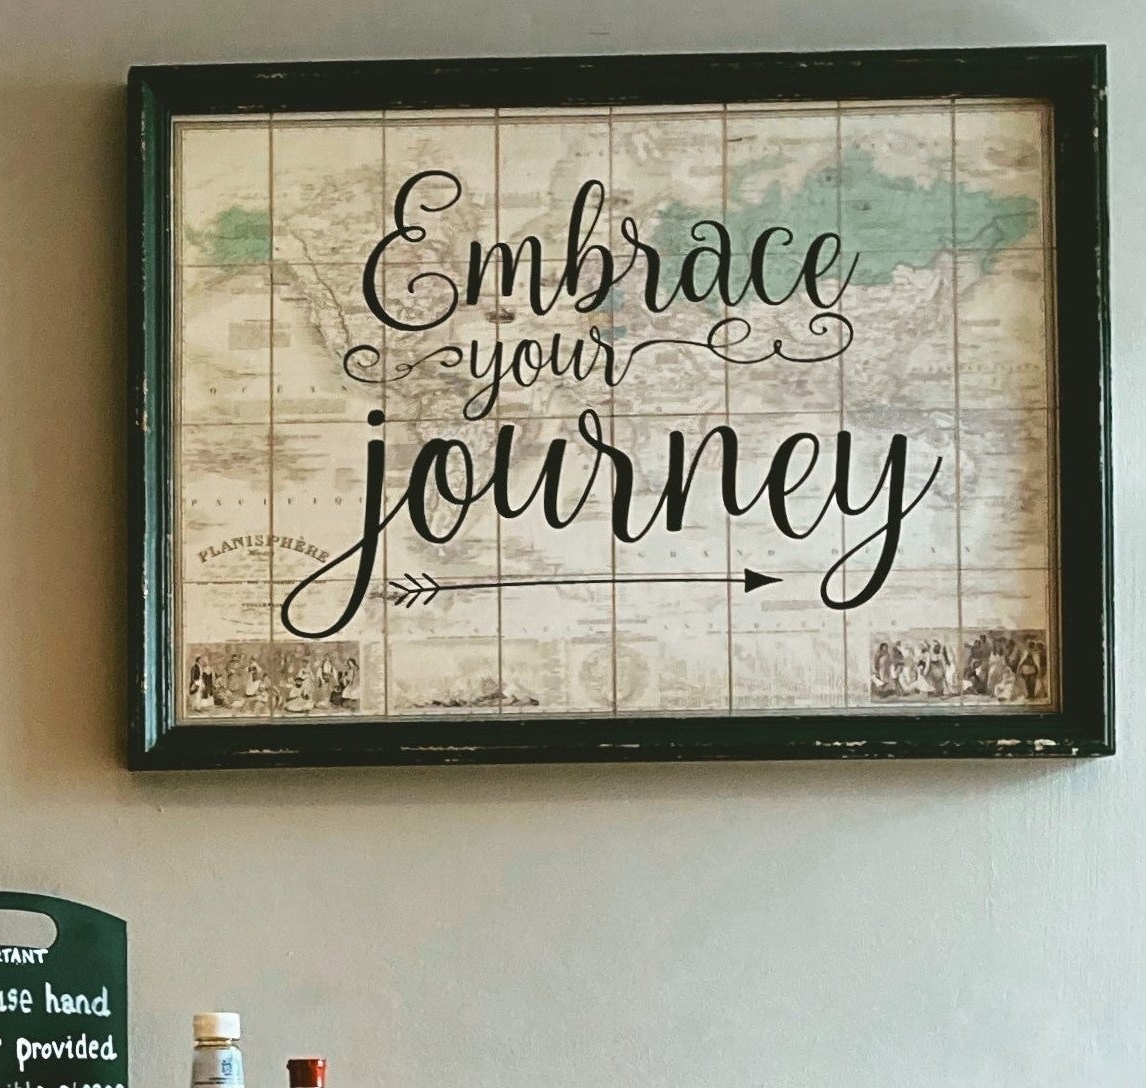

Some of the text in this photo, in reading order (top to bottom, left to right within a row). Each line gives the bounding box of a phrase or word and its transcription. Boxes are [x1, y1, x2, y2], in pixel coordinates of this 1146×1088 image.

[363, 169, 860, 332] Embrace
[281, 409, 943, 639] journey
[45, 981, 112, 1018] hand
[16, 1032, 118, 1072] provided
